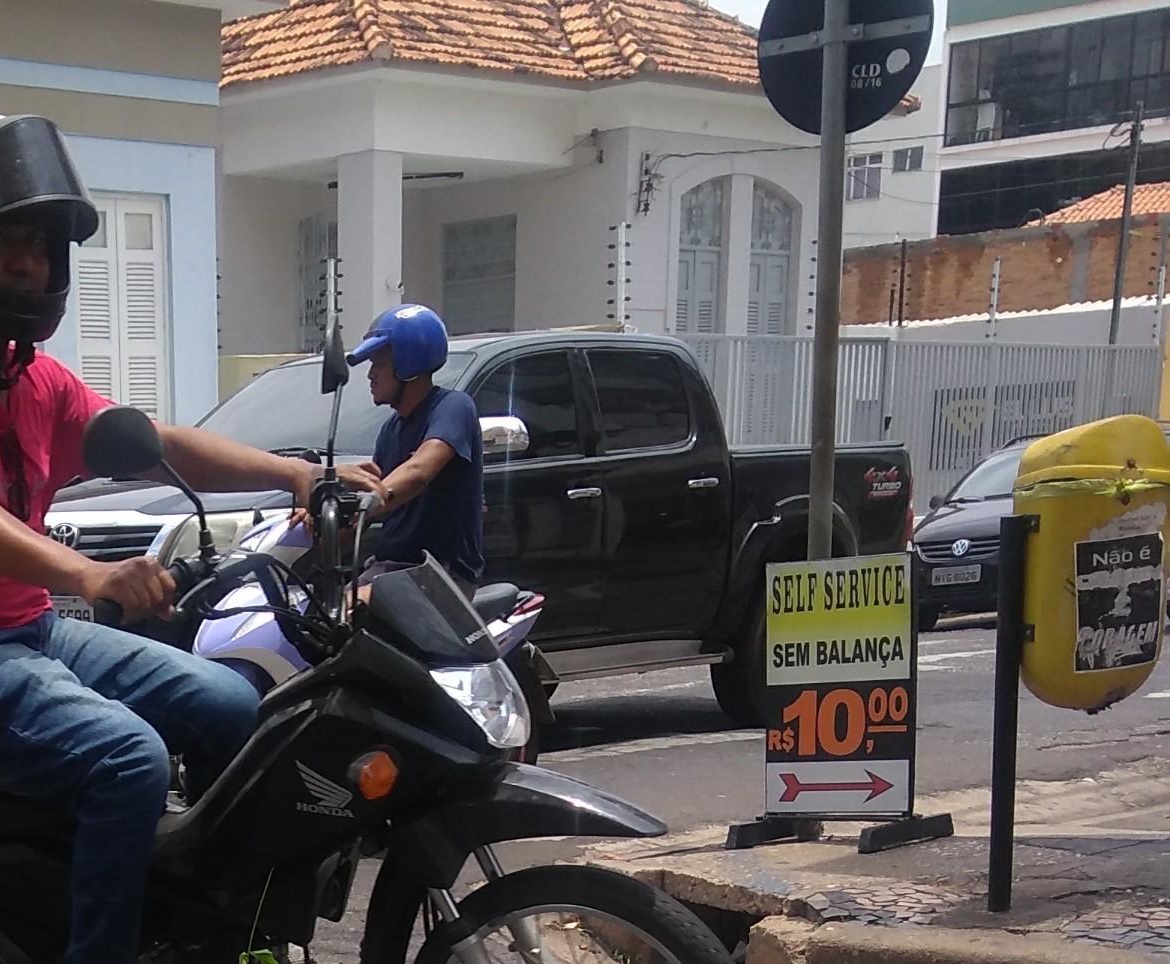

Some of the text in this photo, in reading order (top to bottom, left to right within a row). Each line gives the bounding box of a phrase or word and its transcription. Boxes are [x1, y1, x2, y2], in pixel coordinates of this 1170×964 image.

[852, 63, 881, 78] CLD
[872, 481, 902, 491] TURBO
[1092, 545, 1151, 567] Não é
[772, 565, 905, 614] SELF SERVICE
[773, 636, 904, 668] SEM BALANÇA
[296, 802, 355, 818] HONDA
